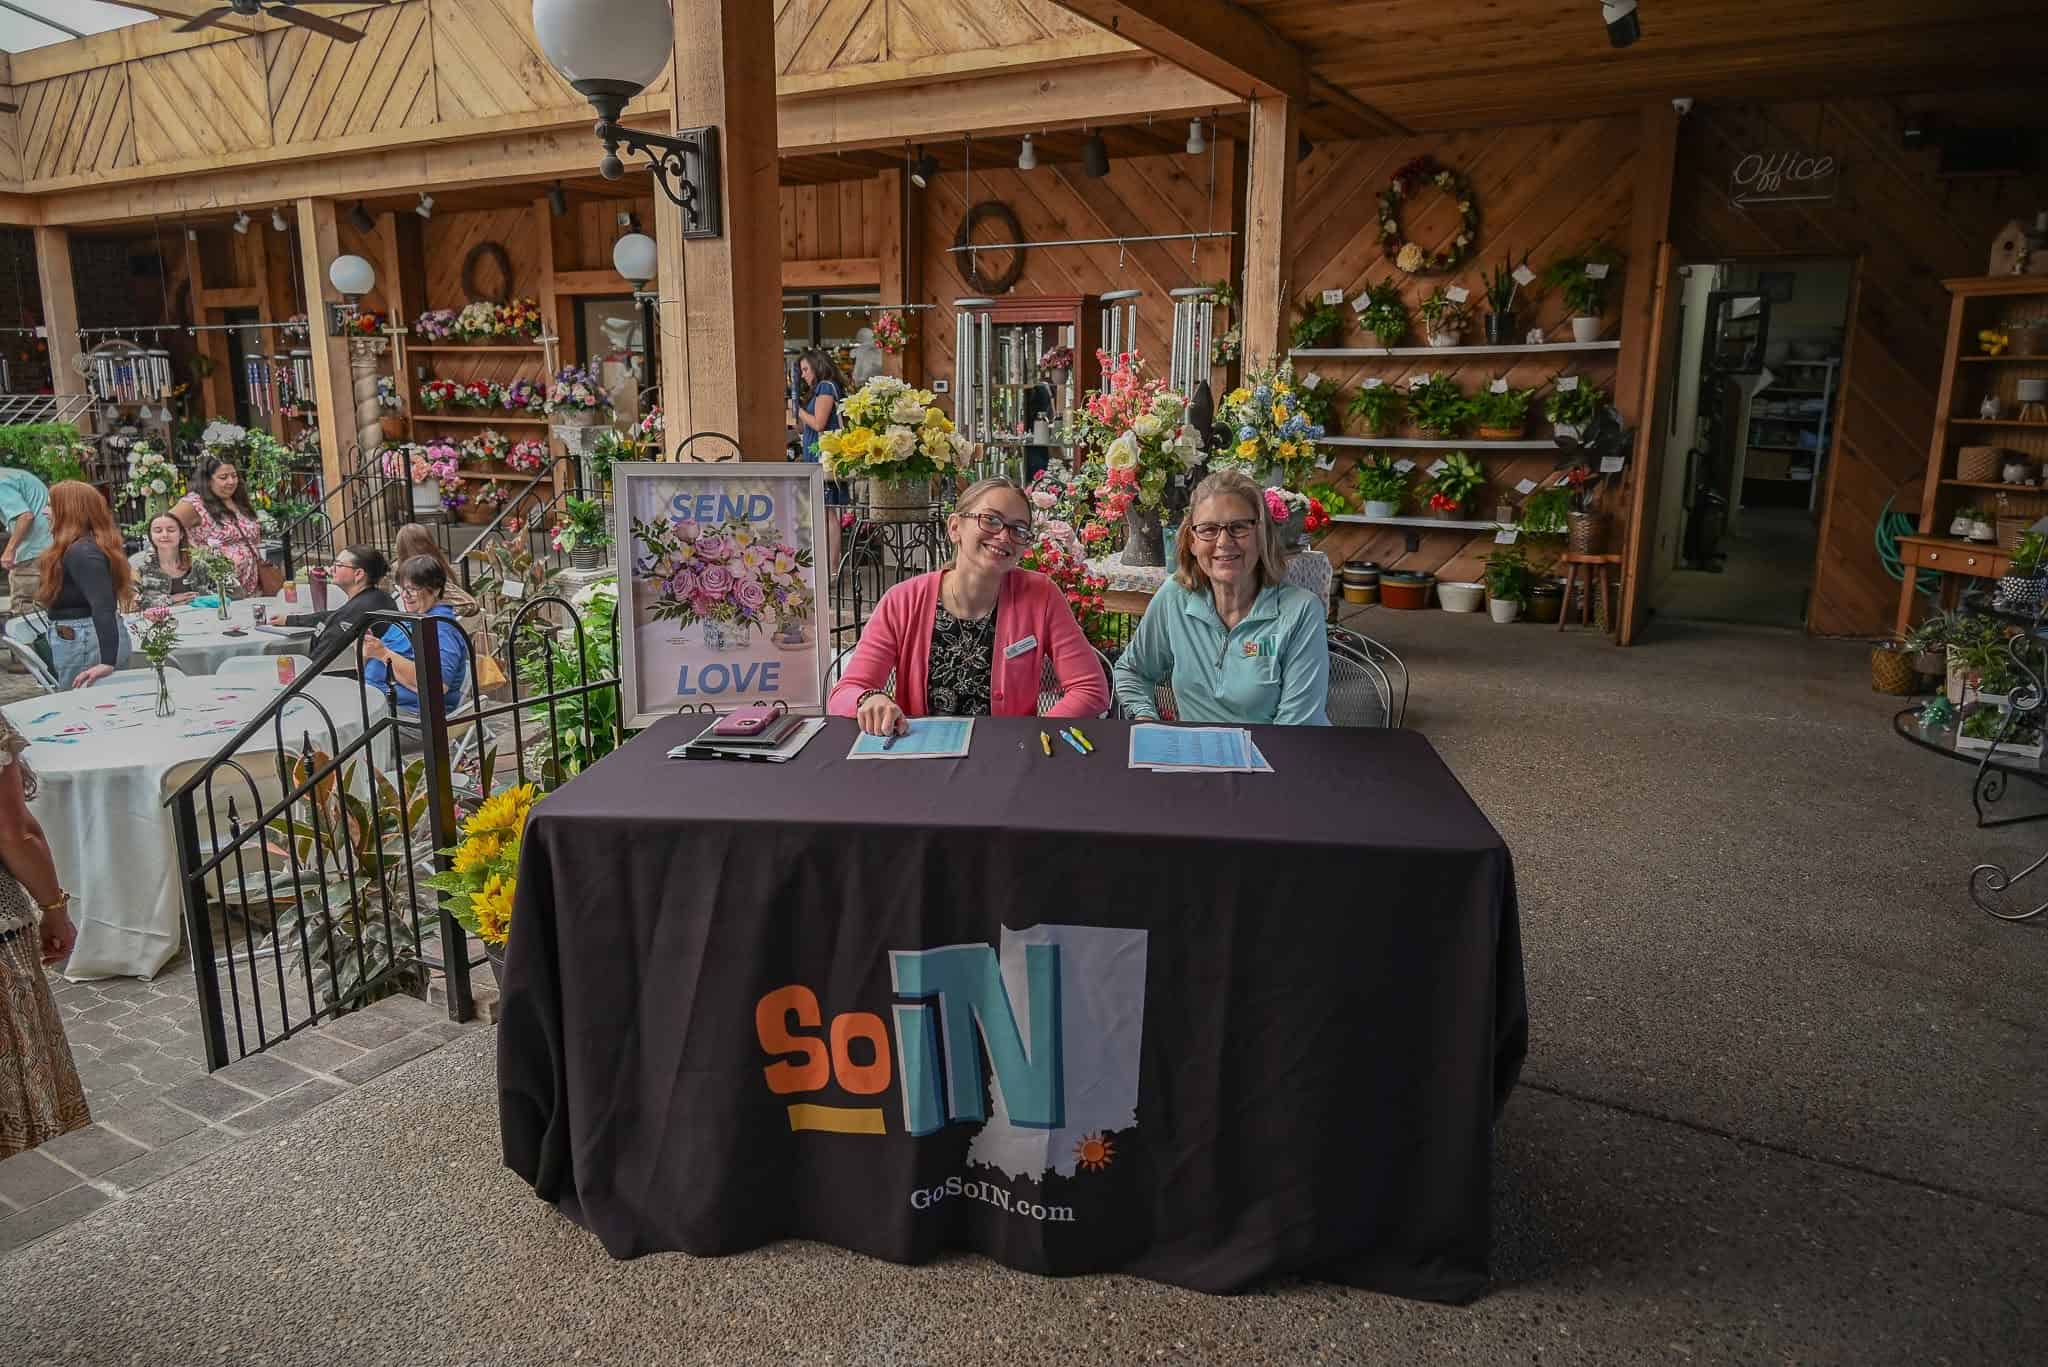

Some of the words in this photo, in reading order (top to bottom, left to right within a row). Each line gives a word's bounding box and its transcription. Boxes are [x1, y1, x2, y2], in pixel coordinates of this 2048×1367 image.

[1734, 152, 1834, 192] Office
[670, 494, 774, 522] SEND
[677, 661, 782, 695] LOVE
[910, 1176, 1076, 1222] GoSoIN.com
